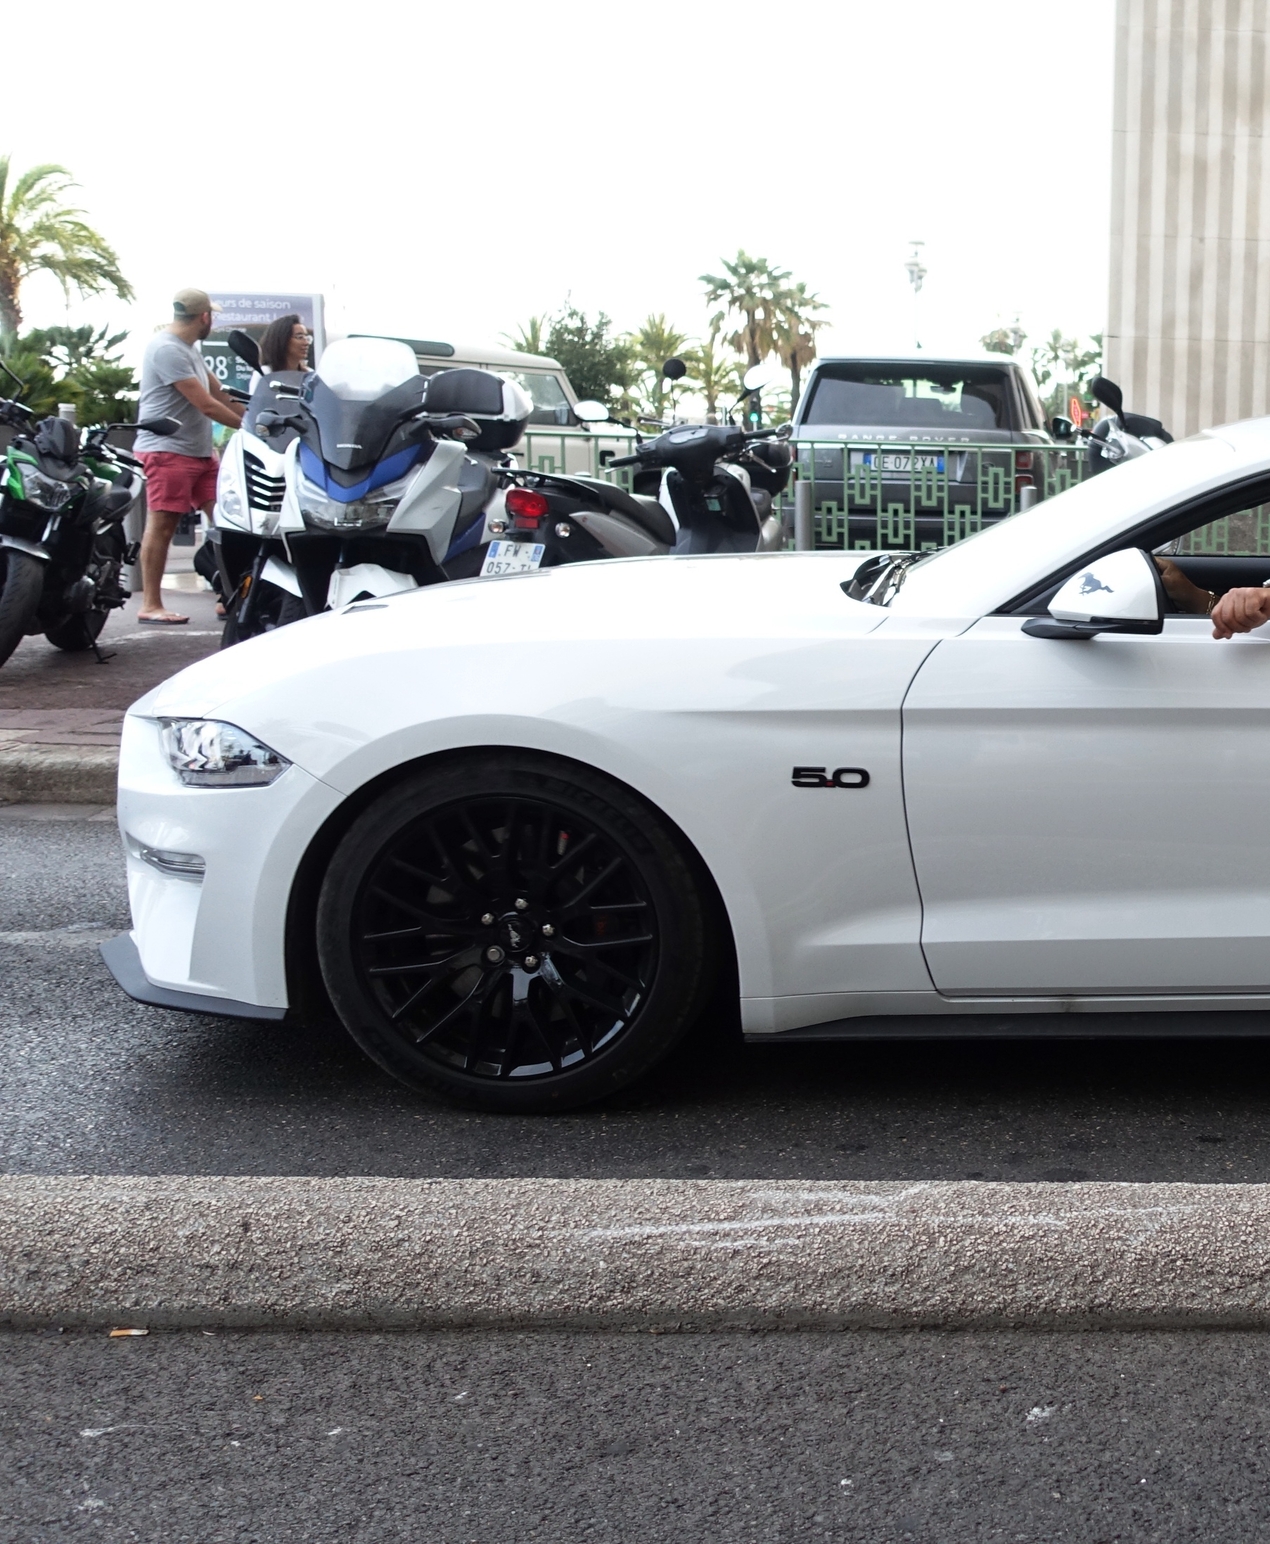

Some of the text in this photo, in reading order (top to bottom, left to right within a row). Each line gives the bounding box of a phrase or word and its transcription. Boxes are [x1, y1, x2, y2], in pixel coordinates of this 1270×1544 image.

[238, 298, 251, 308] de
[254, 299, 291, 310] saison
[791, 766, 870, 788] 5.0
